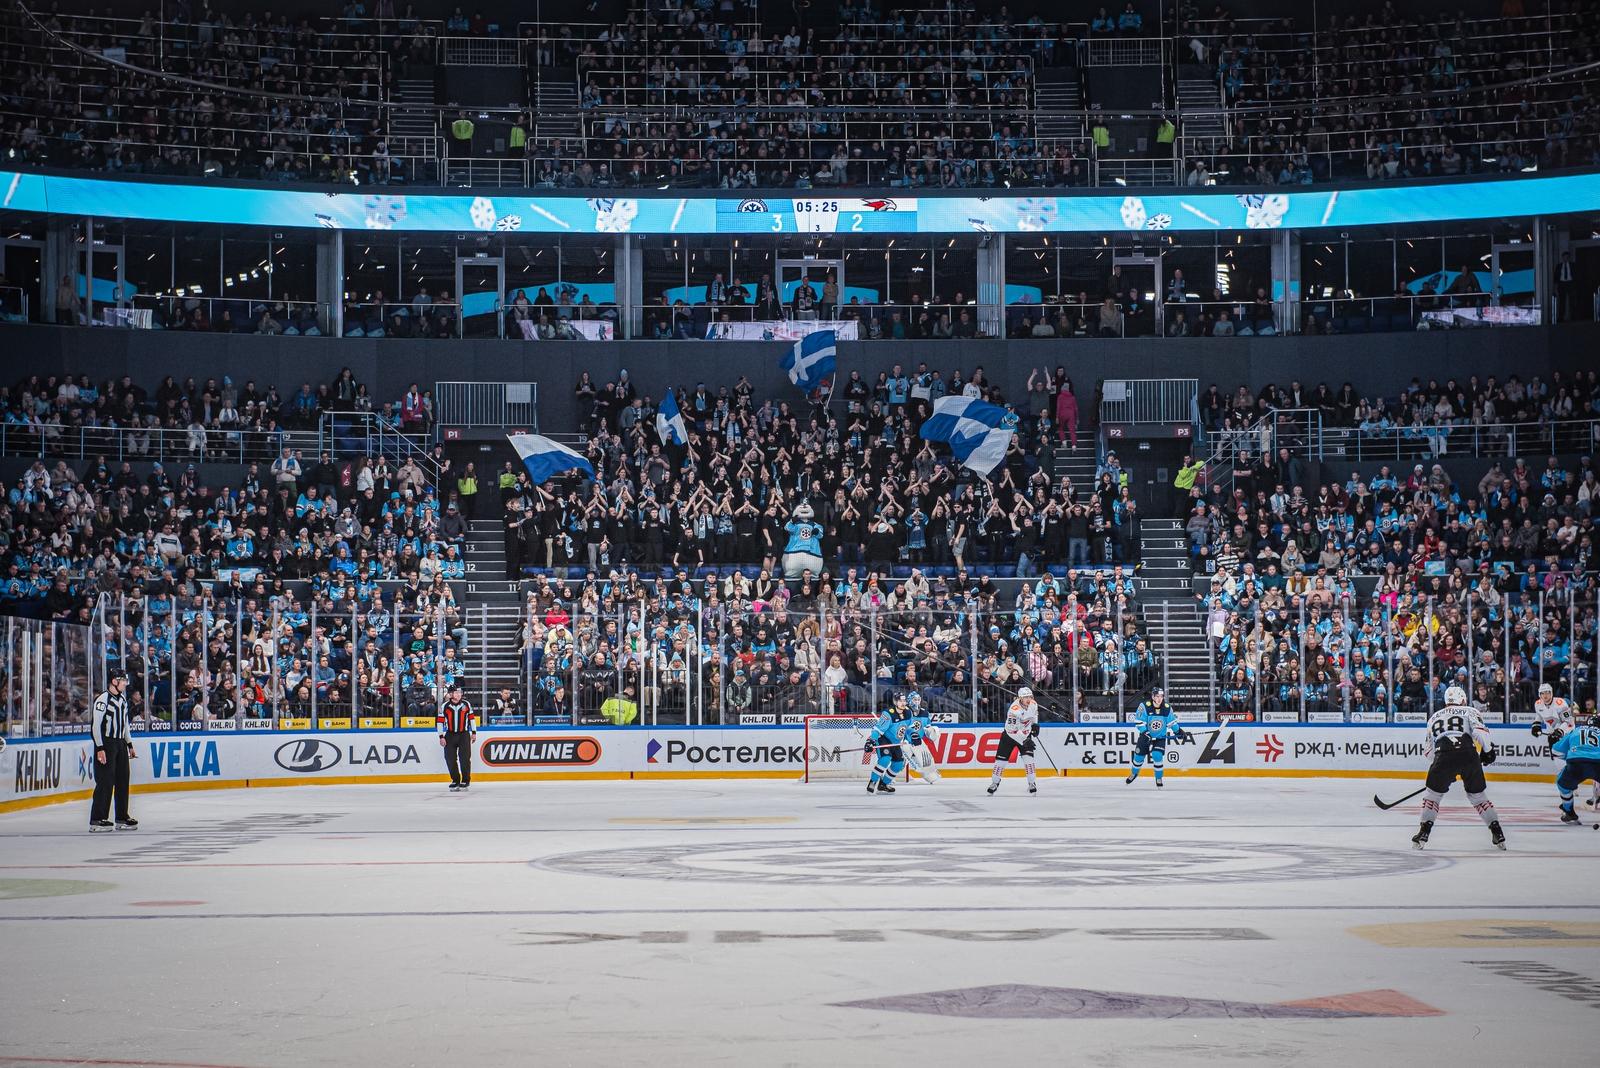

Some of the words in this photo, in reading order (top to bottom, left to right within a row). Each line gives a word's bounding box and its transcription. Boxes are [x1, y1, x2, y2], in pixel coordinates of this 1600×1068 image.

[796, 202, 838, 212] 05:25
[772, 214, 783, 231] 3
[852, 214, 863, 231] 2
[1172, 521, 1182, 529] 14
[1175, 541, 1184, 549] 13
[467, 563, 476, 571] 12
[1177, 560, 1187, 568] 12
[468, 584, 476, 592] 11
[509, 584, 516, 592] 11
[1141, 580, 1148, 588] 11
[1180, 580, 1188, 588] 11
[245, 720, 270, 728] KHL.RU
[742, 716, 774, 724] KHL.RU
[210, 721, 234, 729] KHL.RU
[1431, 715, 1464, 737] 88
[1579, 729, 1599, 747] 15
[349, 745, 421, 764] LADA
[490, 743, 574, 760] WINLINE
[667, 740, 841, 763] Ростелеком
[150, 741, 221, 778] VEKA
[1082, 750, 1097, 764] &
[15, 748, 61, 793] KHL.RU
